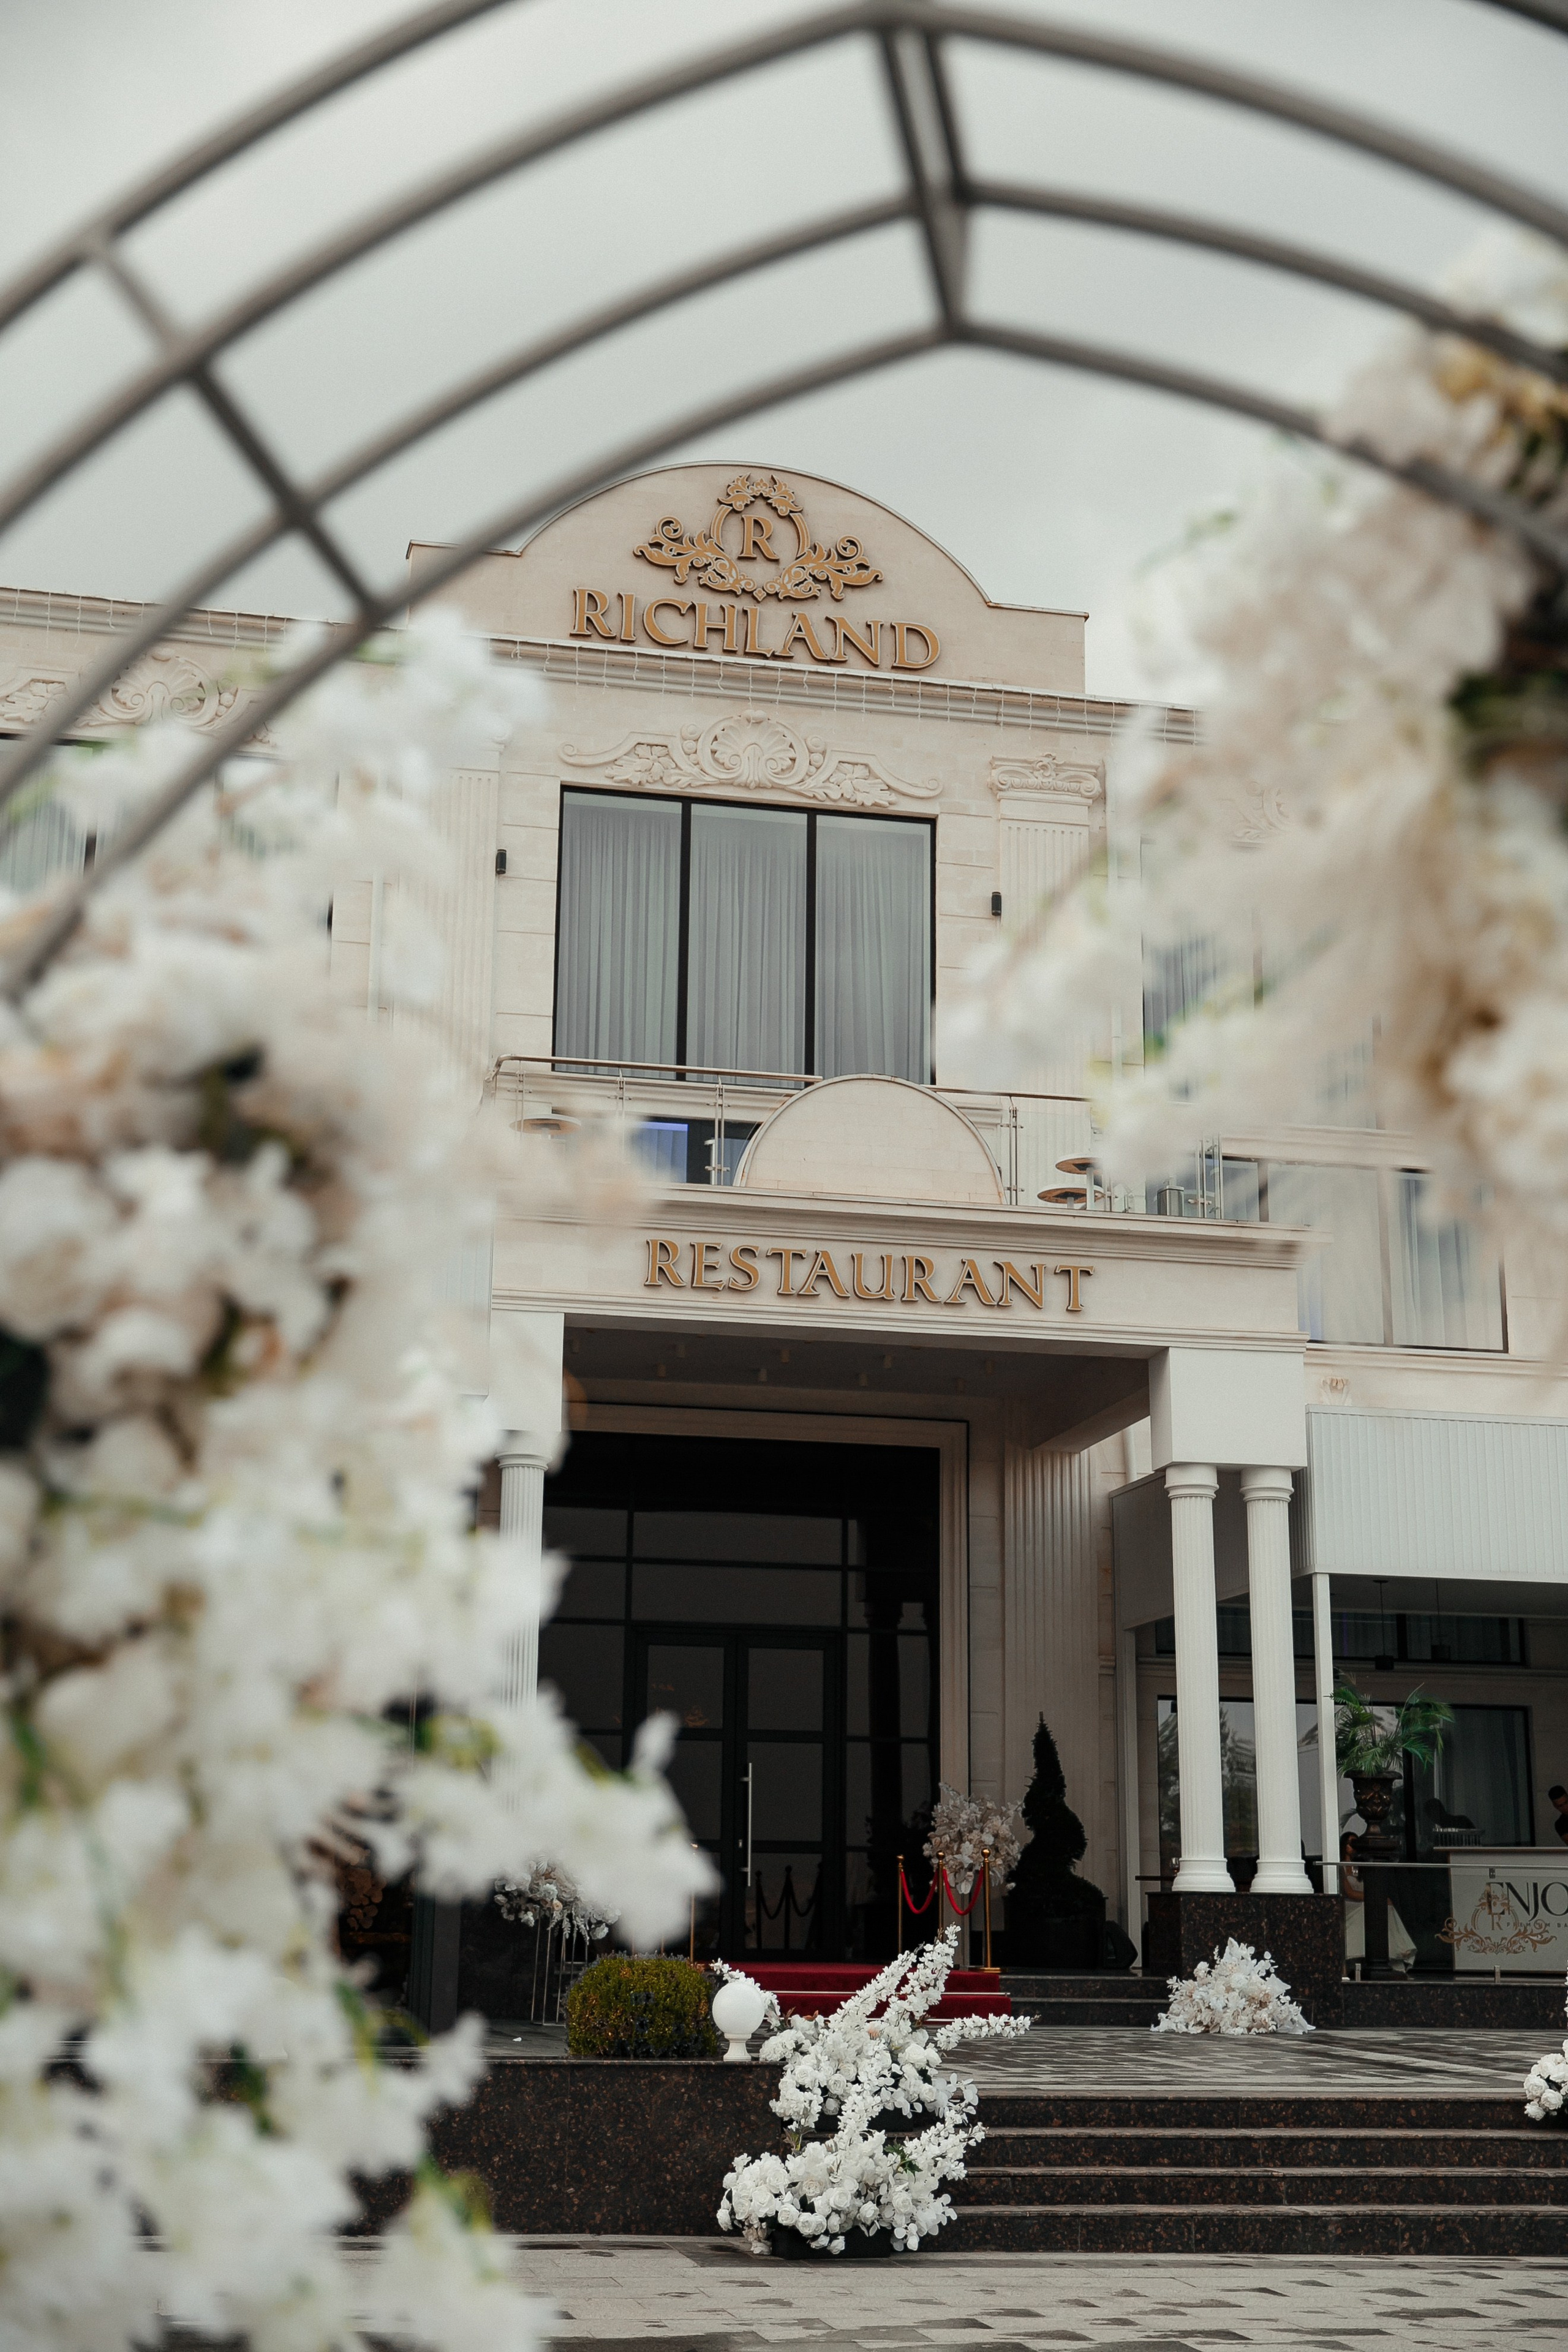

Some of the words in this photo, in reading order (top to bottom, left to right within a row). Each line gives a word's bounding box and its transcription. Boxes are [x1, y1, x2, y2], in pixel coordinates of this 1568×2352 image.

[737, 513, 780, 561] R
[570, 587, 941, 669] RICHLAND
[644, 1238, 1095, 1311] RESTAURANT
